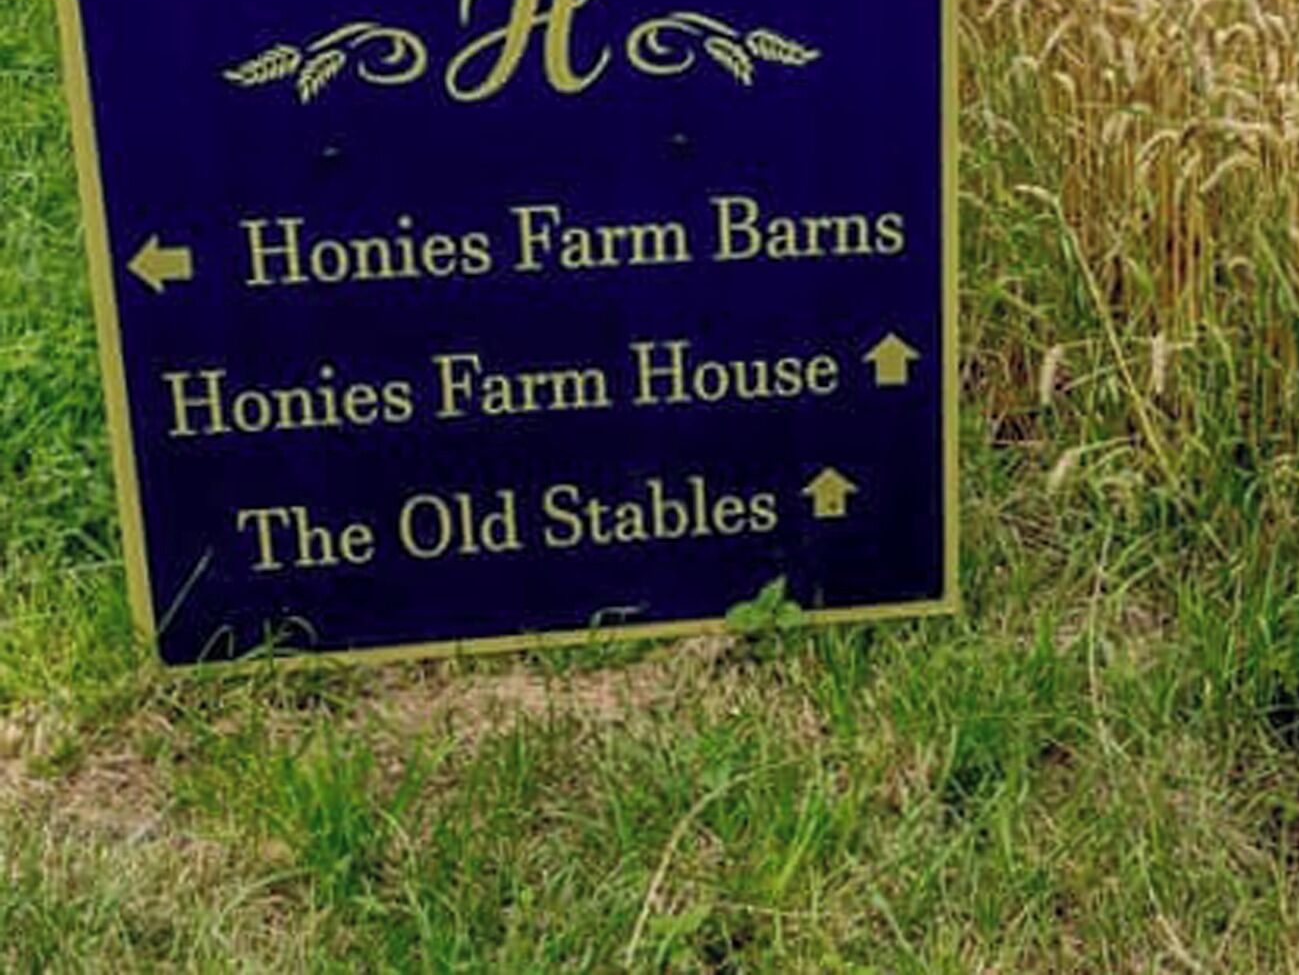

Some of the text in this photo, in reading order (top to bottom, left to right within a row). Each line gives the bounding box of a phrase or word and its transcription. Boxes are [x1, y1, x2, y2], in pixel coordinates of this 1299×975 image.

[241, 196, 904, 286] Honies Farm Barns
[164, 340, 838, 436] Honies Farm House
[237, 476, 777, 570] The Old Stables
